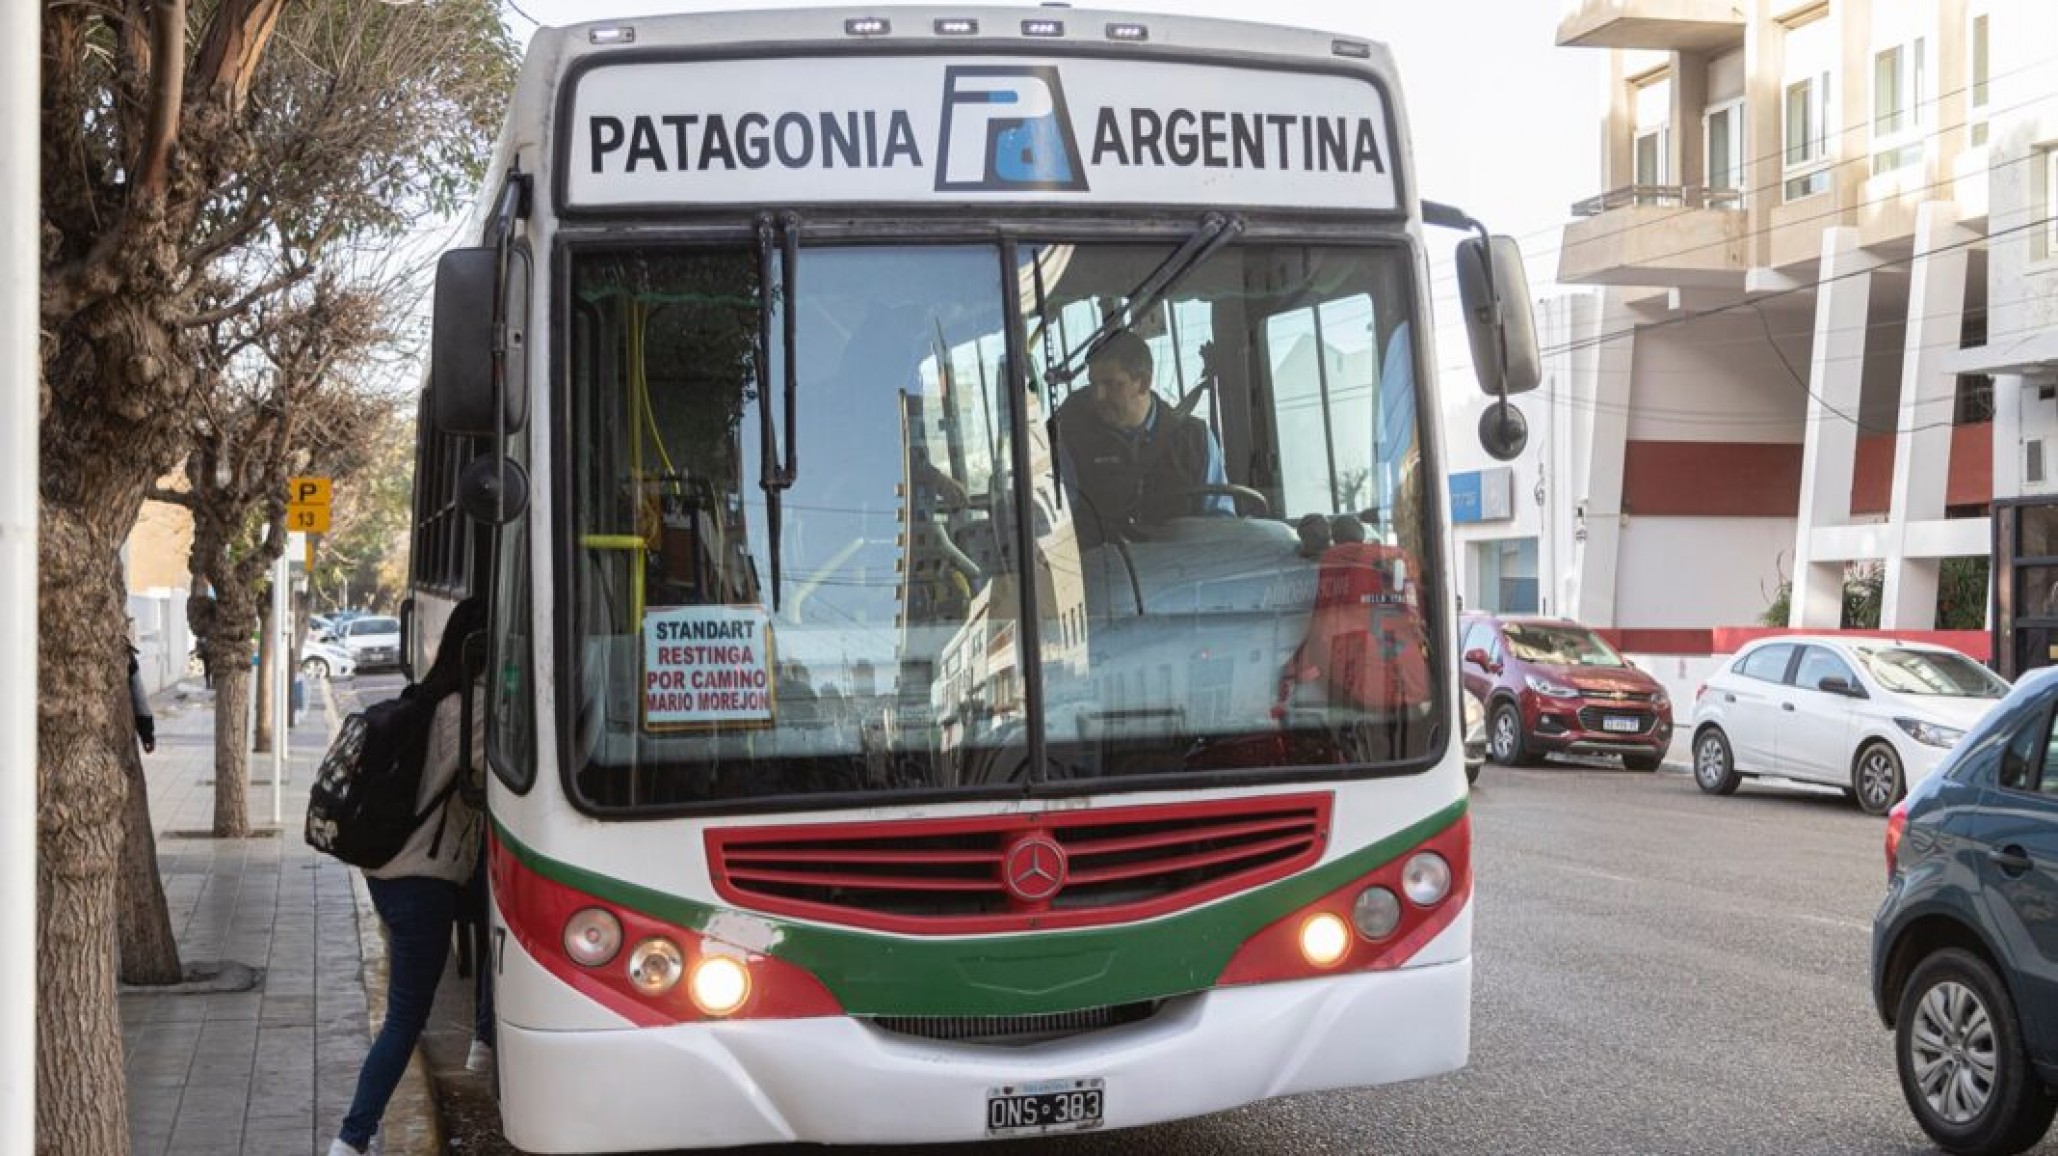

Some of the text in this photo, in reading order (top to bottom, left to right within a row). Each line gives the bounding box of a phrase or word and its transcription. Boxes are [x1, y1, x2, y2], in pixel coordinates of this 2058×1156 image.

[589, 109, 924, 174] PATAGONIA
[1091, 105, 1386, 174] ARGENTINA
[300, 482, 317, 502] P
[298, 511, 315, 528] 13
[656, 620, 756, 641] STANDART
[658, 645, 754, 665] RESTINGA
[646, 668, 767, 690] POR CAMINO
[646, 690, 771, 712] MARIO MOREJON
[991, 1091, 1100, 1127] ONS 383
